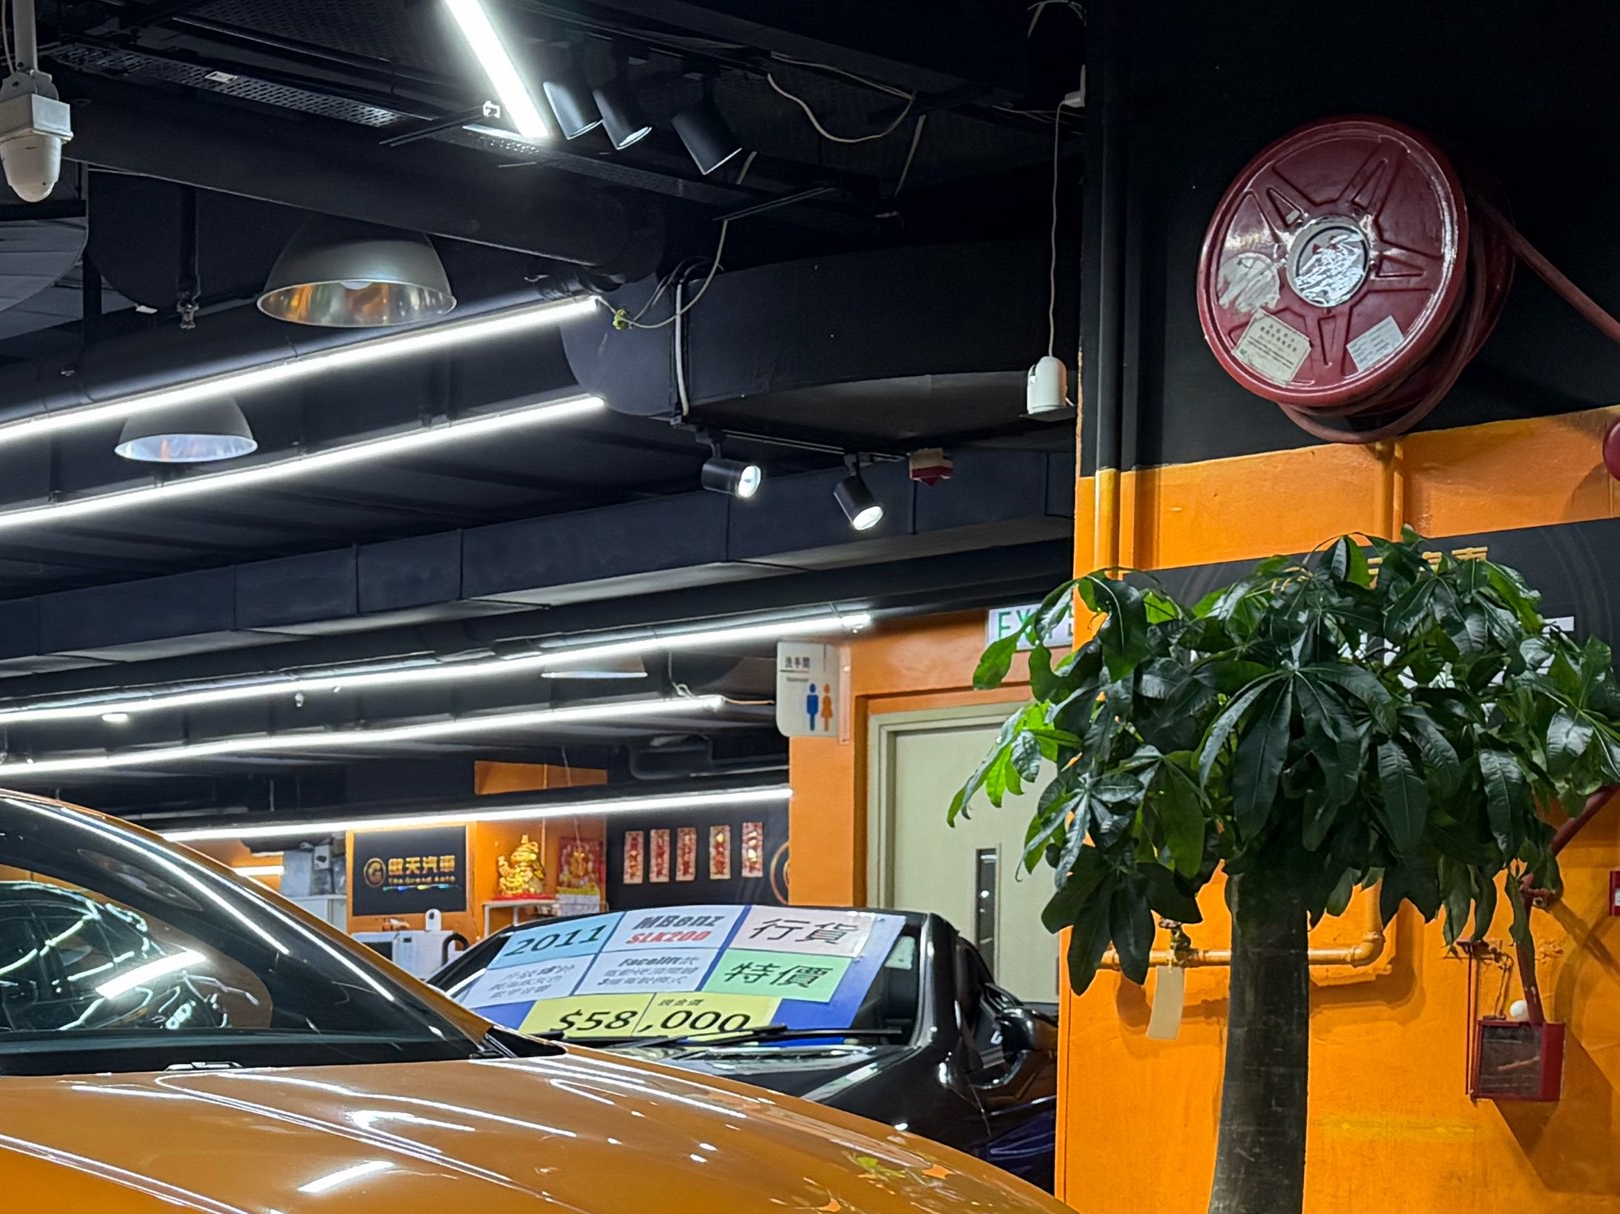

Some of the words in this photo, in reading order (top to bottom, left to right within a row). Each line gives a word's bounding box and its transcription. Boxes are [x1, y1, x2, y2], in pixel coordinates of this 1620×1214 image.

[631, 915, 725, 930] MBenz
[748, 917, 859, 945] 行貨
[503, 924, 607, 957] 2011
[625, 930, 712, 944] SLK200
[724, 961, 834, 988] 特價
